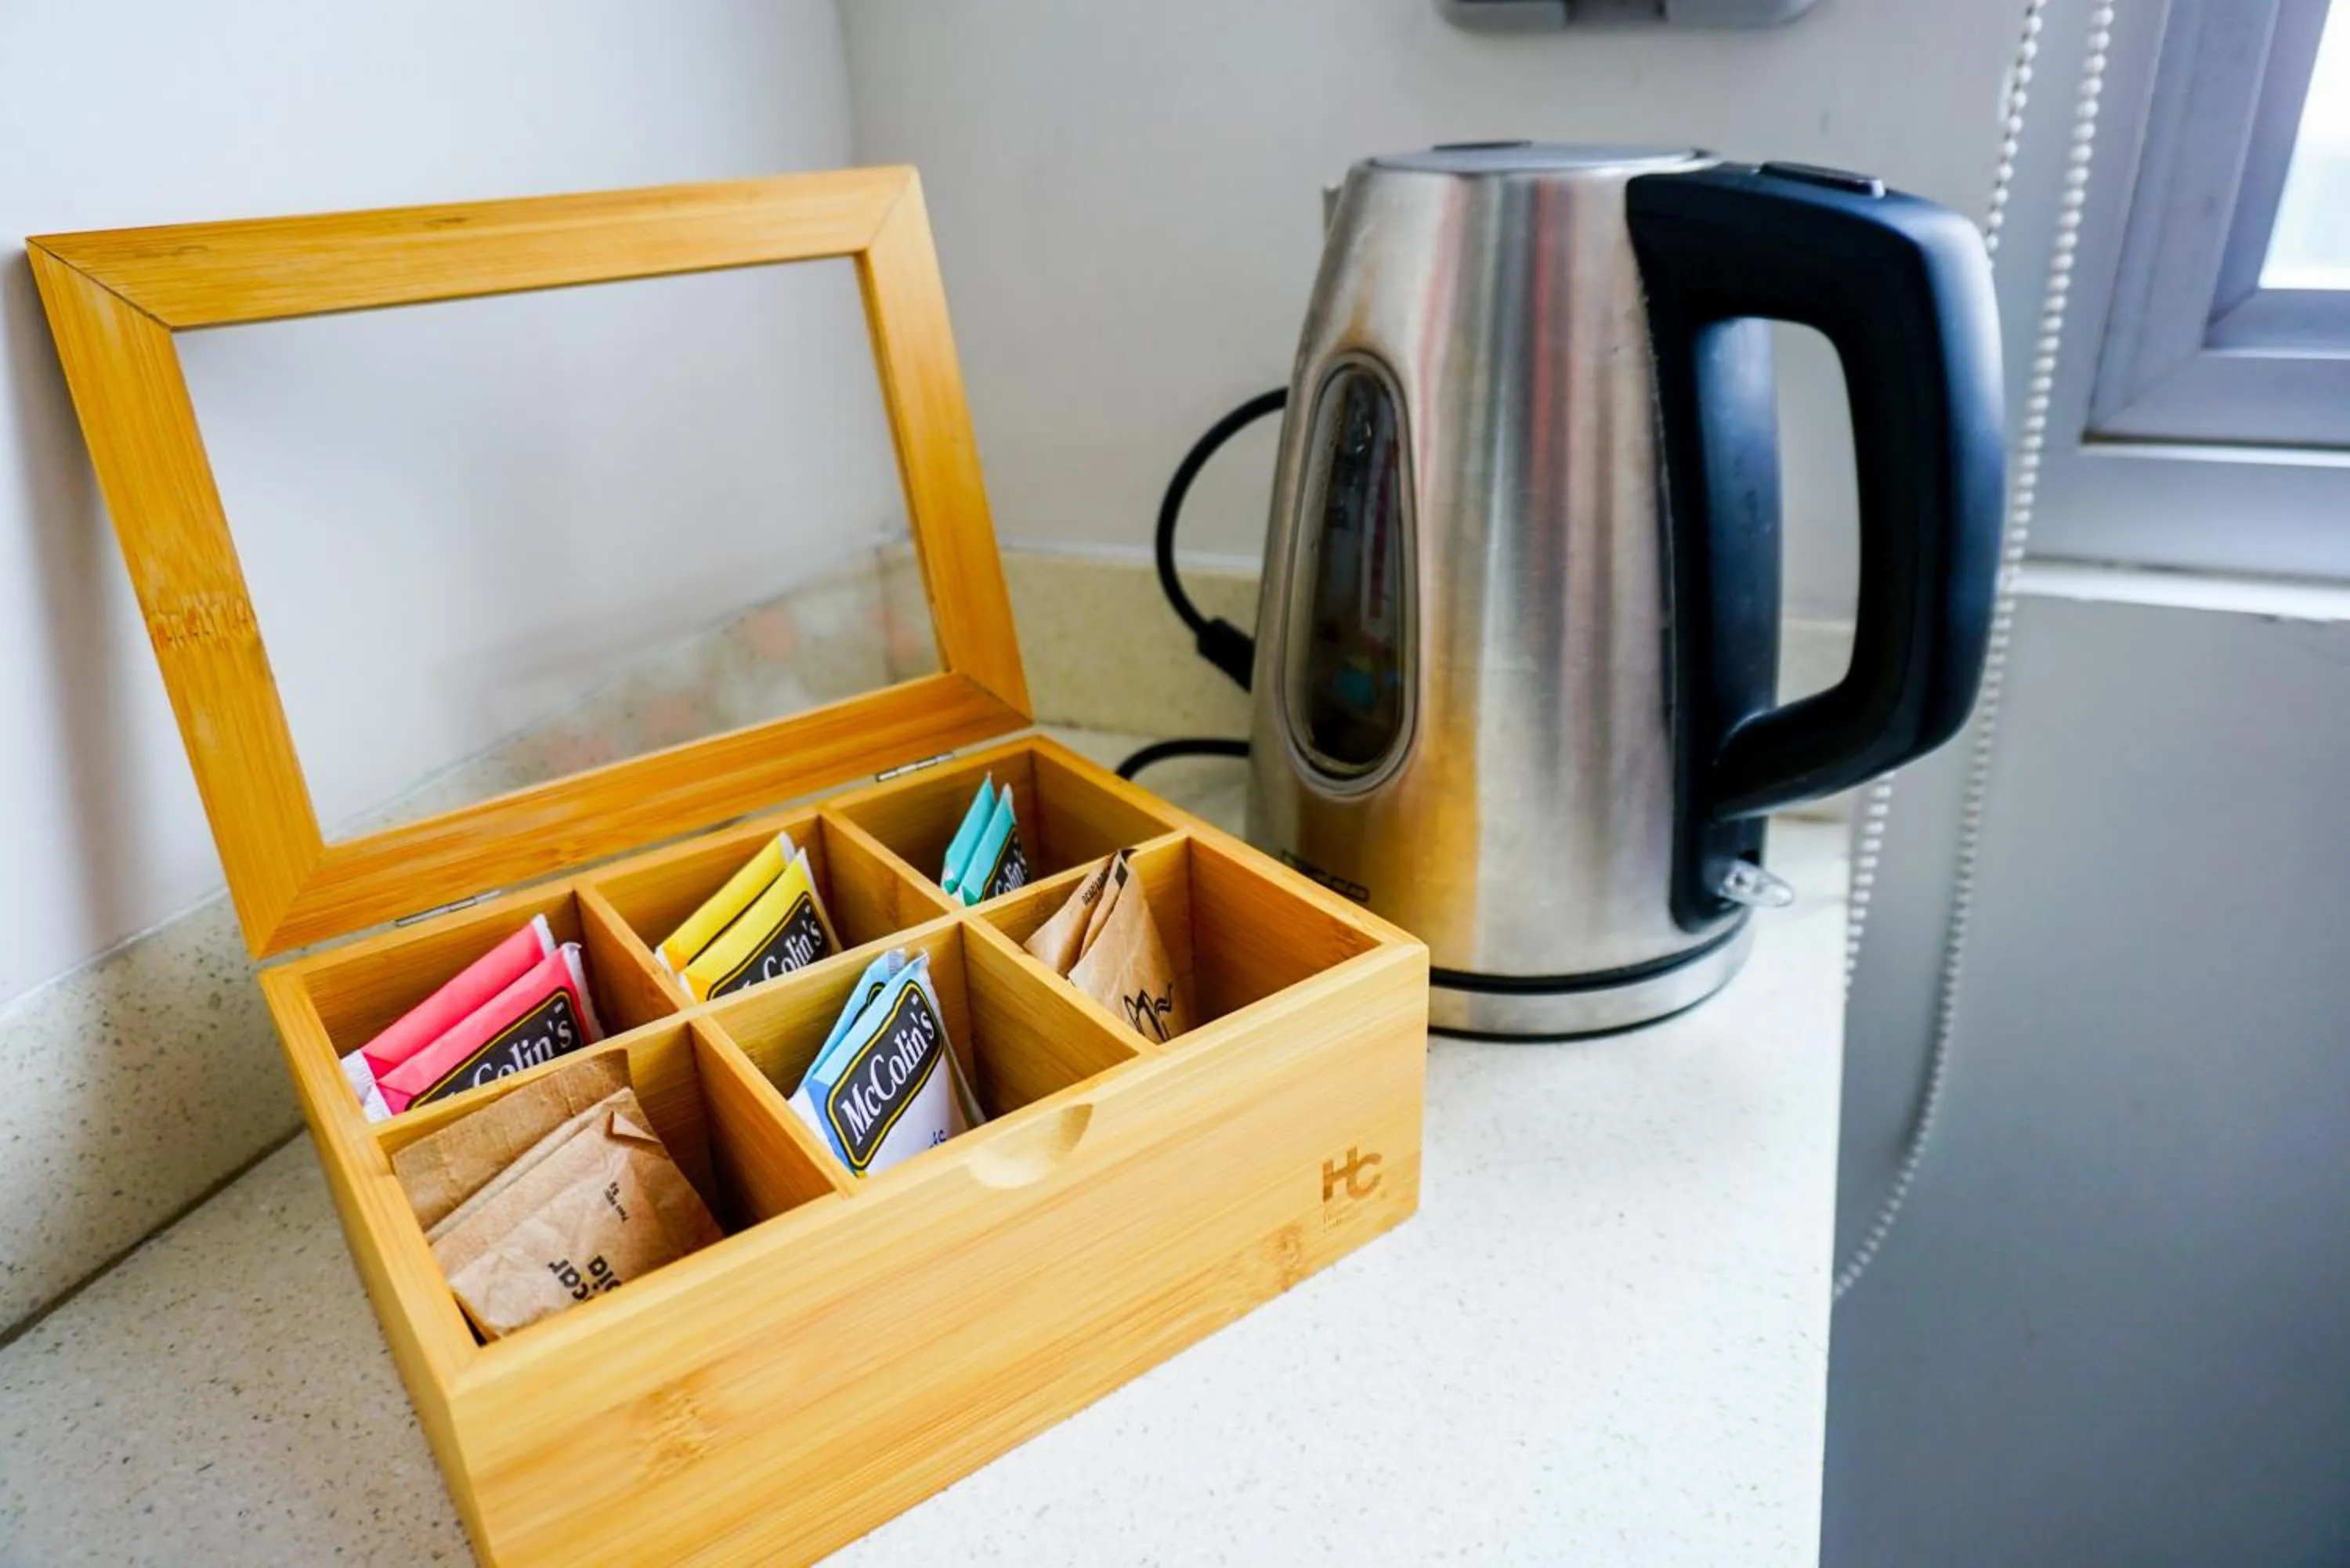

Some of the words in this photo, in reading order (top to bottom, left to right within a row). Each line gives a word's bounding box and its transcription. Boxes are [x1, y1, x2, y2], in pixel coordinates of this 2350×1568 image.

[742, 919, 822, 988] Colin's
[446, 1019, 573, 1097] Colin's
[841, 1010, 935, 1145] McColin's
